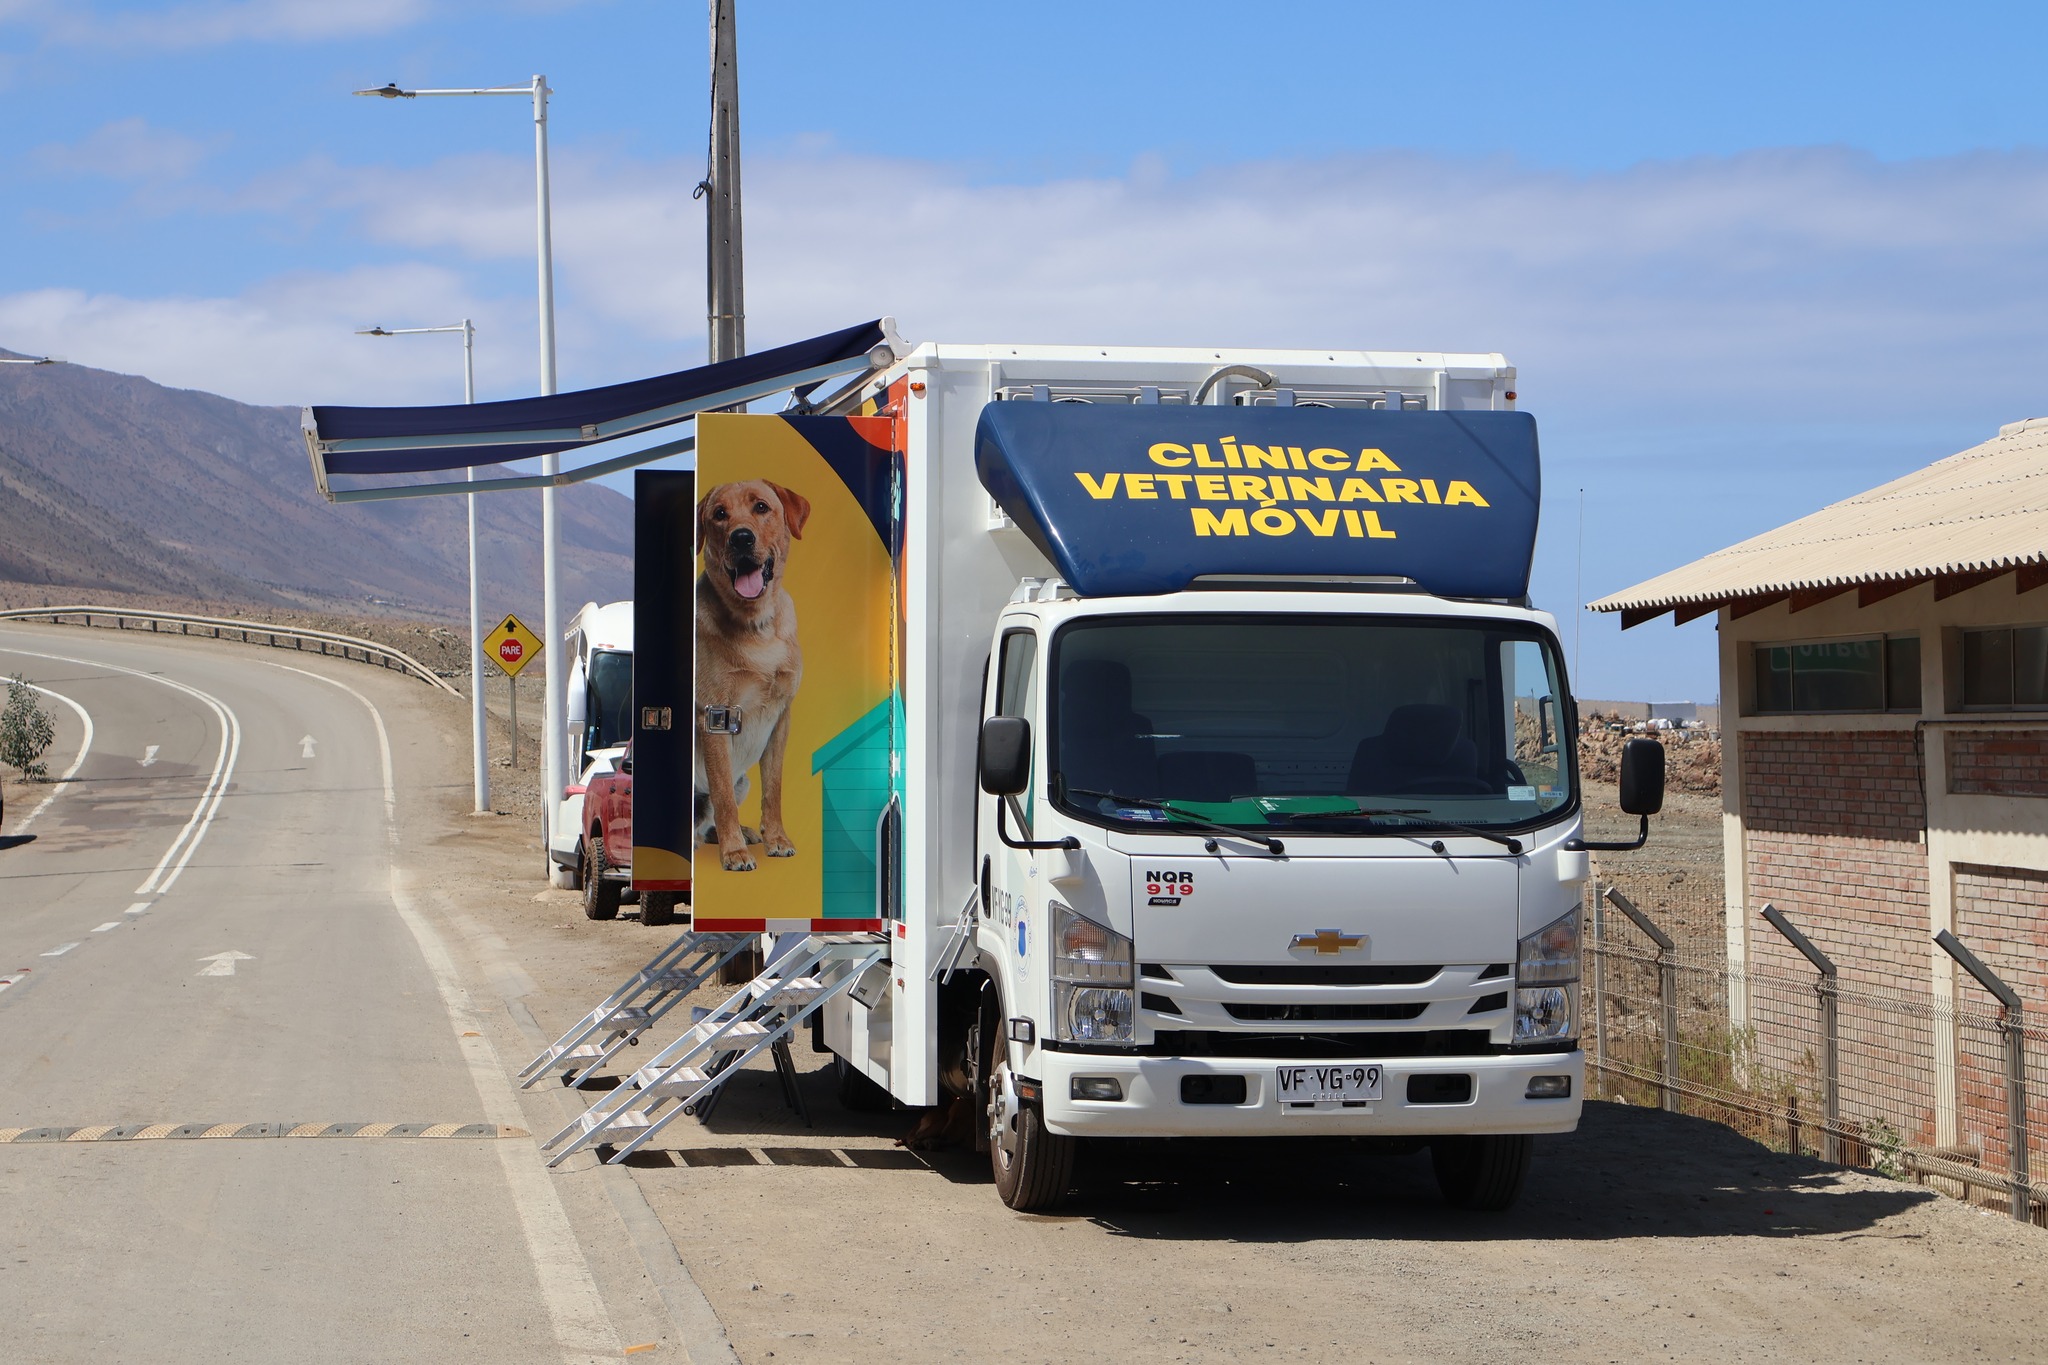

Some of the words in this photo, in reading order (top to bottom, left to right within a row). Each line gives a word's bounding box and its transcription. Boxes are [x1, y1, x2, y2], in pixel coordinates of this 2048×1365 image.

[1148, 435, 1402, 472] CLÍNICA
[1073, 472, 1491, 507] VETERINARIA
[1190, 500, 1397, 539] MÓVIL
[501, 645, 521, 655] PARE
[1146, 871, 1194, 883] NQR
[1146, 884, 1194, 895] 919
